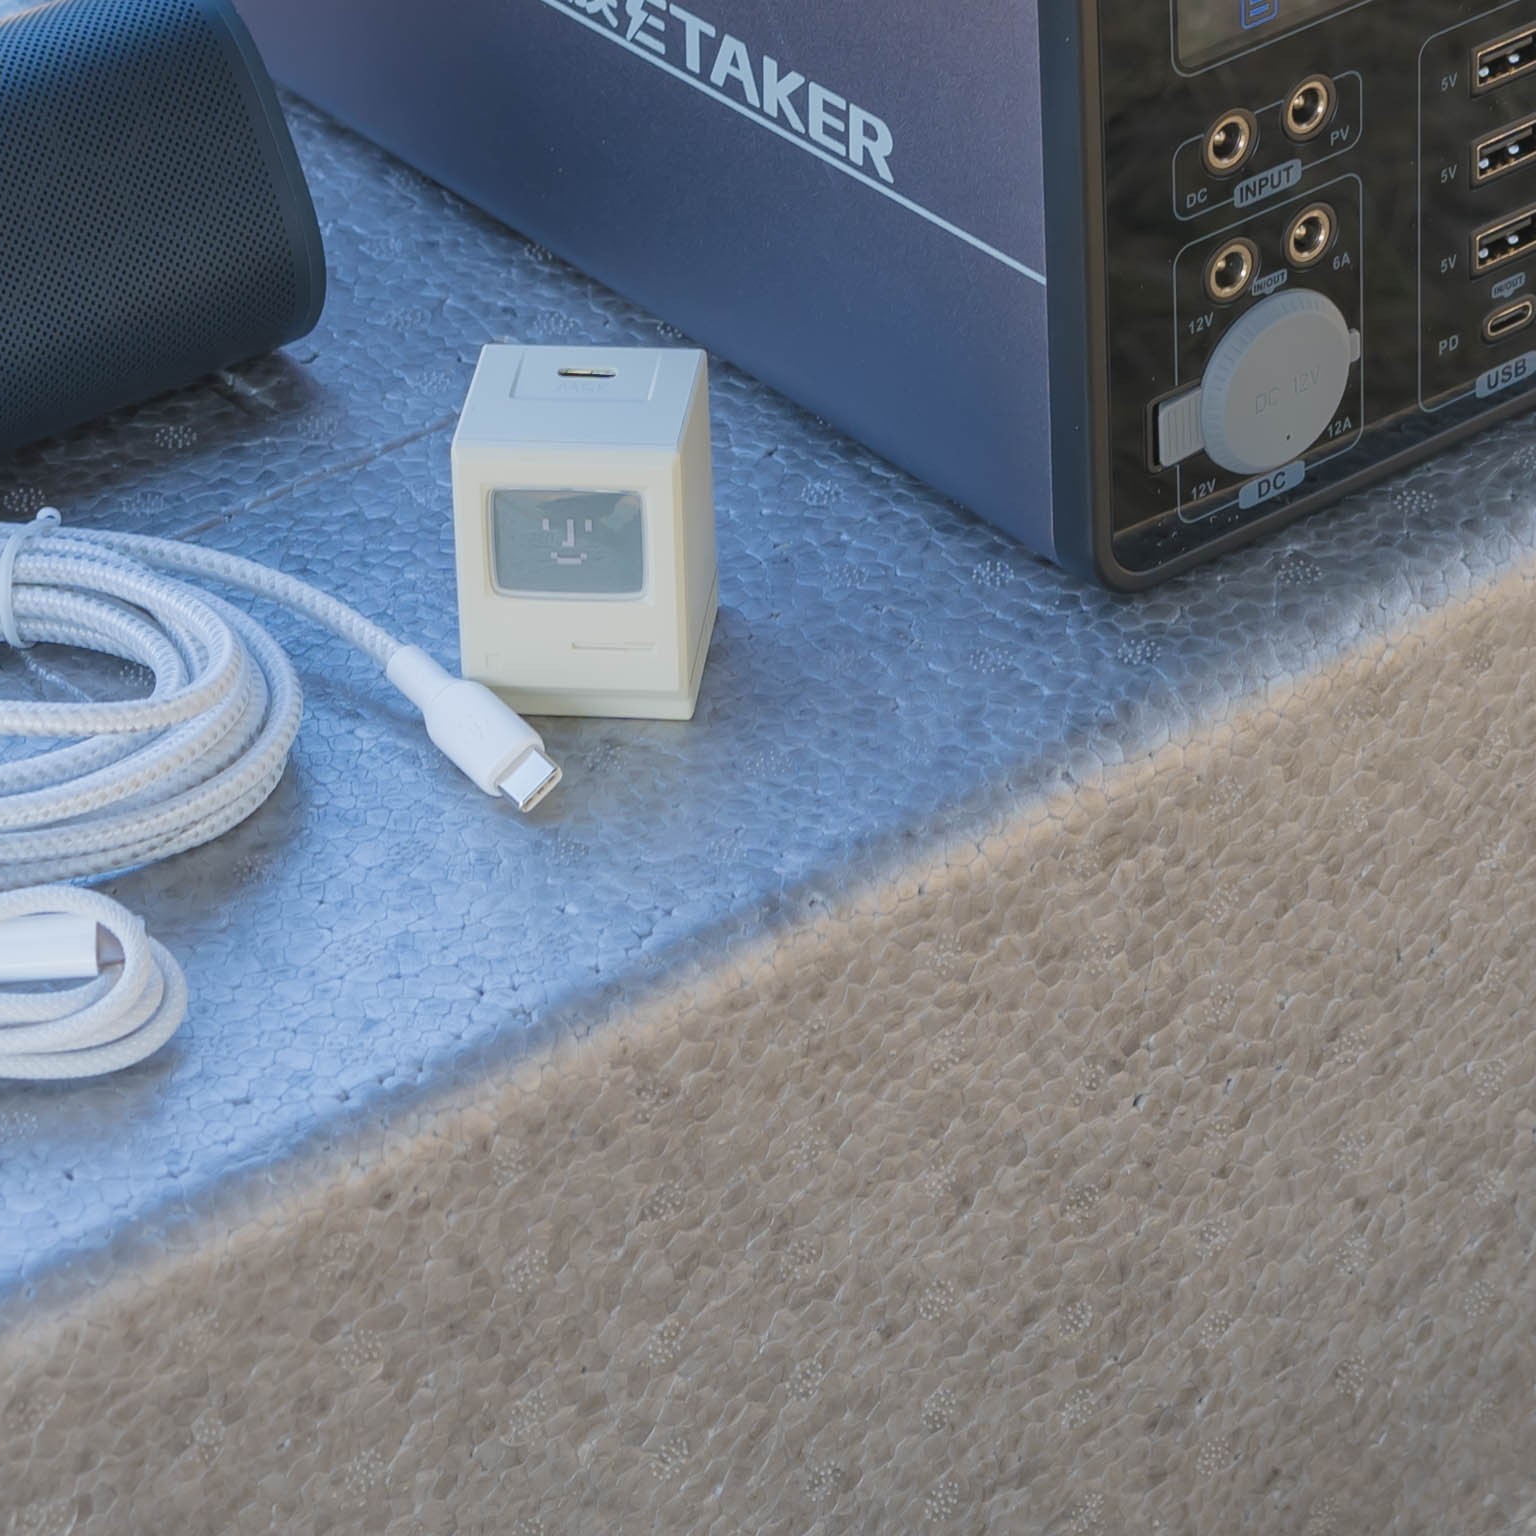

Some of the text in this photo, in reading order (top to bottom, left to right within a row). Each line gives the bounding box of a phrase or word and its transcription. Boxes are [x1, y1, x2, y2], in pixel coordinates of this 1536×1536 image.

[1440, 71, 1458, 93] 5V
[1329, 125, 1350, 147] PV
[1239, 164, 1295, 205] INPUT
[1440, 164, 1457, 184] 5V
[1186, 186, 1208, 209] DC
[1332, 252, 1351, 271] 6A
[1440, 254, 1457, 273] 5V
[1188, 312, 1214, 335] 12V
[1438, 335, 1459, 356] PD
[1486, 358, 1528, 390] USB
[1255, 367, 1320, 415] DC 12V
[1327, 417, 1352, 438] 12A
[1191, 478, 1216, 502] 12V
[1257, 471, 1287, 499] DC
